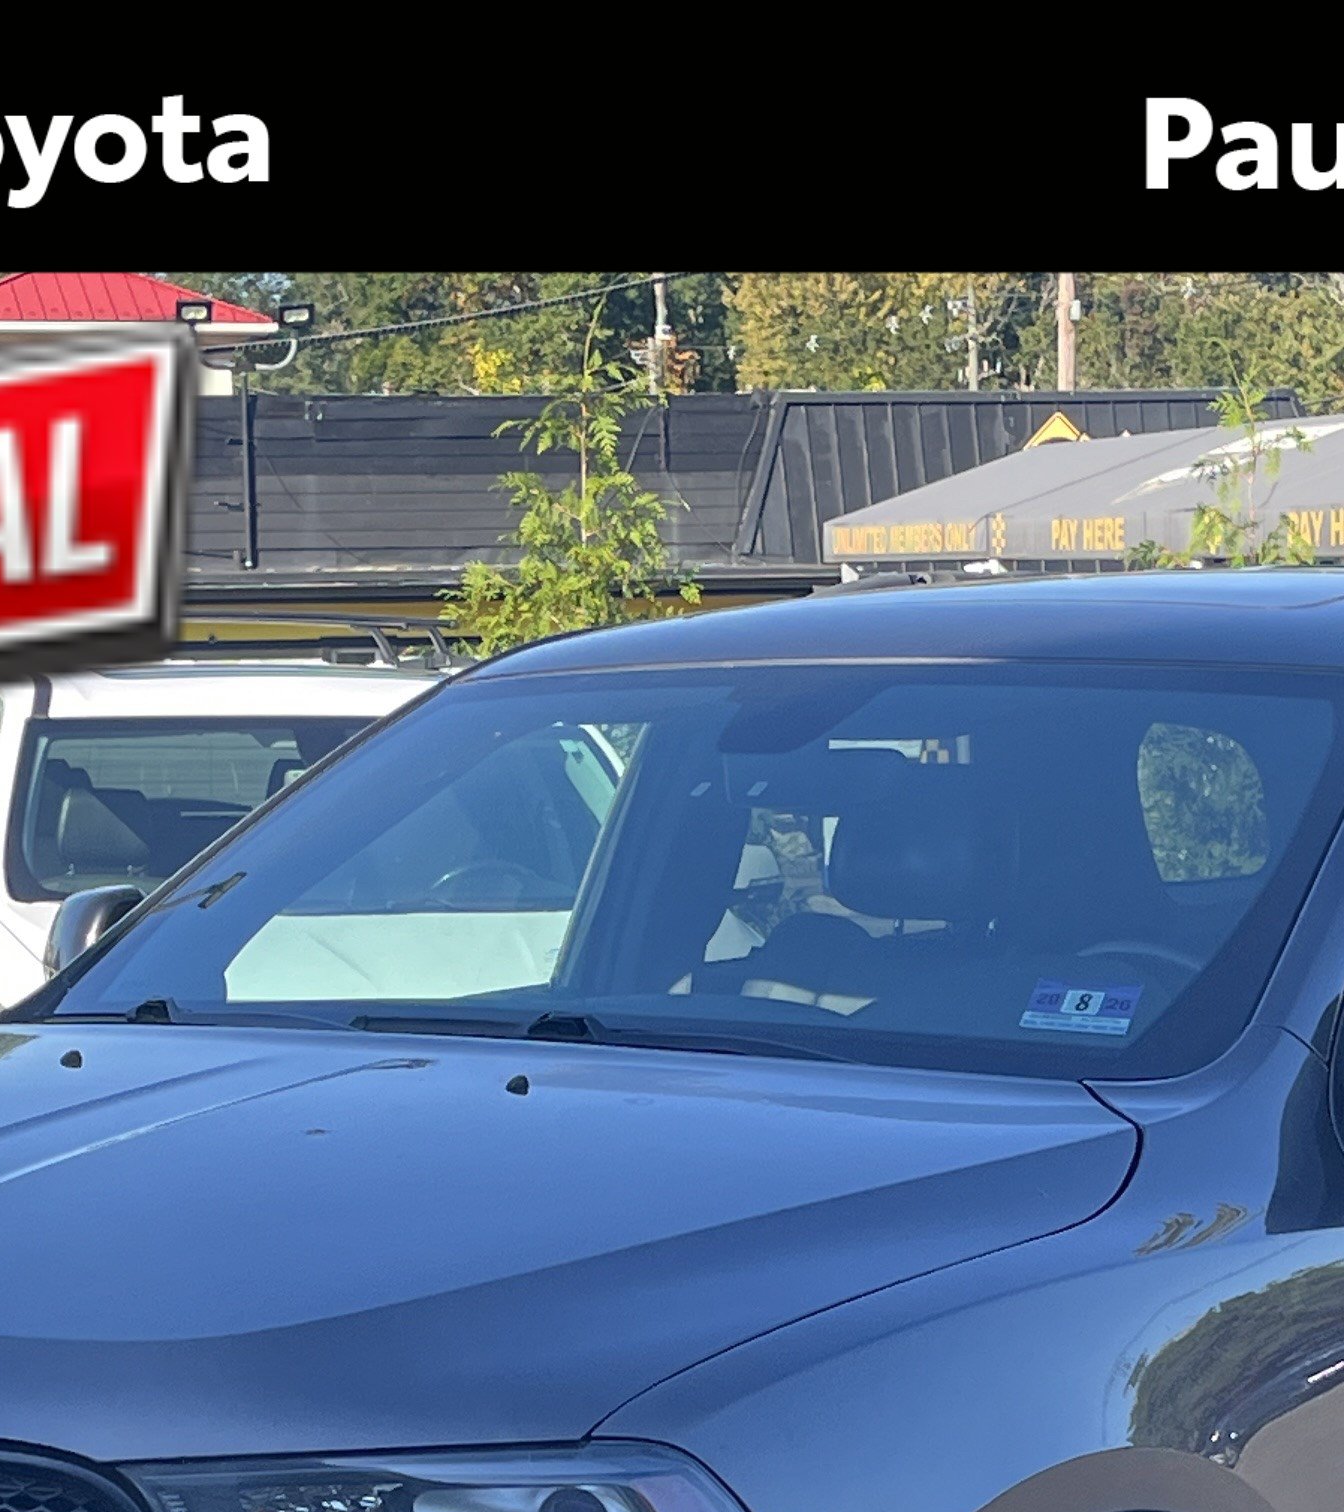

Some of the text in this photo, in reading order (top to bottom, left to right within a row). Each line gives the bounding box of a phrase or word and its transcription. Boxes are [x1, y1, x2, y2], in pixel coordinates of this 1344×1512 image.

[1051, 517, 1125, 550] PAY HERE
[1288, 509, 1324, 548] PAY
[1074, 993, 1093, 1012] 8
